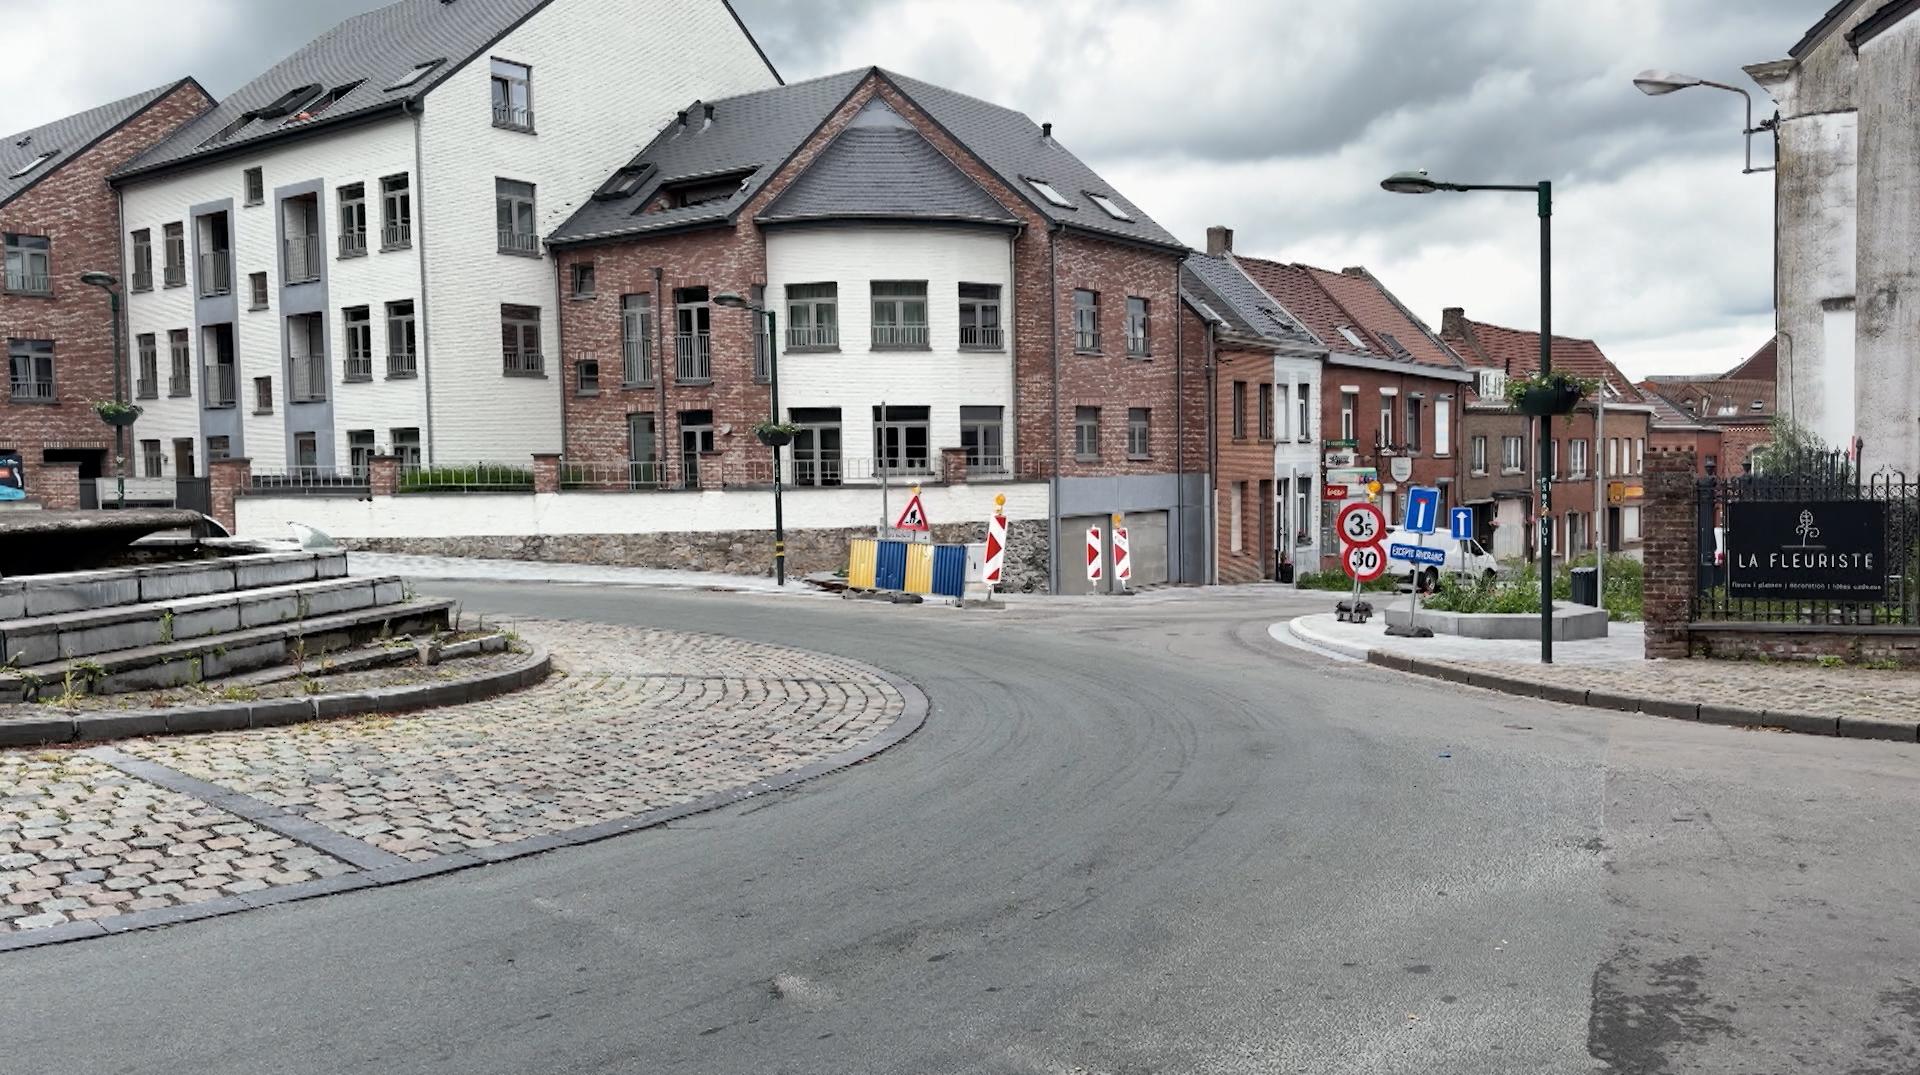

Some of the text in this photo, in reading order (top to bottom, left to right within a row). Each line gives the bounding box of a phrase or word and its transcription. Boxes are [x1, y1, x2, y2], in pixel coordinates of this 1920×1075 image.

[1352, 551, 1378, 569] 30
[1738, 553, 1873, 569] LA FLEURISTE
